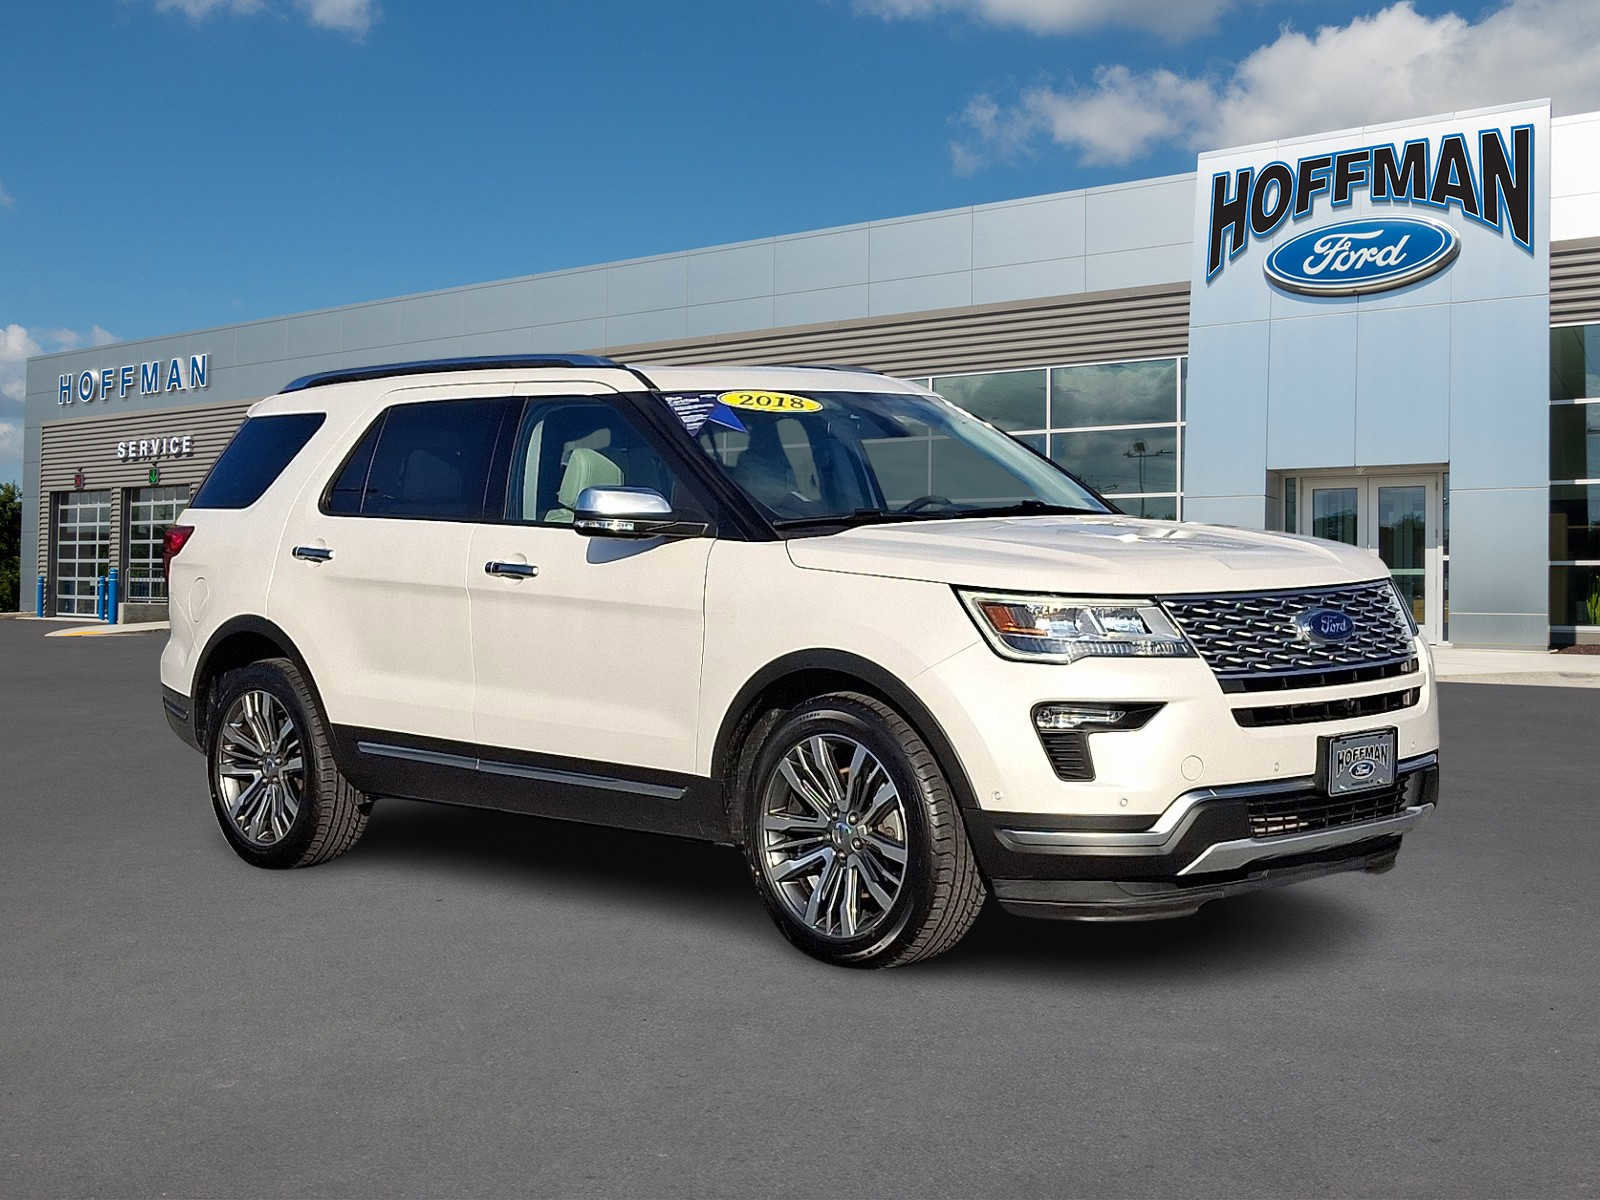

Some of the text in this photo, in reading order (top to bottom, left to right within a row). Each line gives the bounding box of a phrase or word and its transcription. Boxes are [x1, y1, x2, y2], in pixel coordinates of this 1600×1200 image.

[1206, 124, 1534, 282] HOFFMAN
[1303, 229, 1408, 276] Ford
[58, 354, 208, 404] HOFFMAN
[739, 394, 804, 410] 2018
[117, 436, 192, 458] SERVICE
[1320, 615, 1346, 634] Ford
[1336, 744, 1388, 777] HOFFMAN
